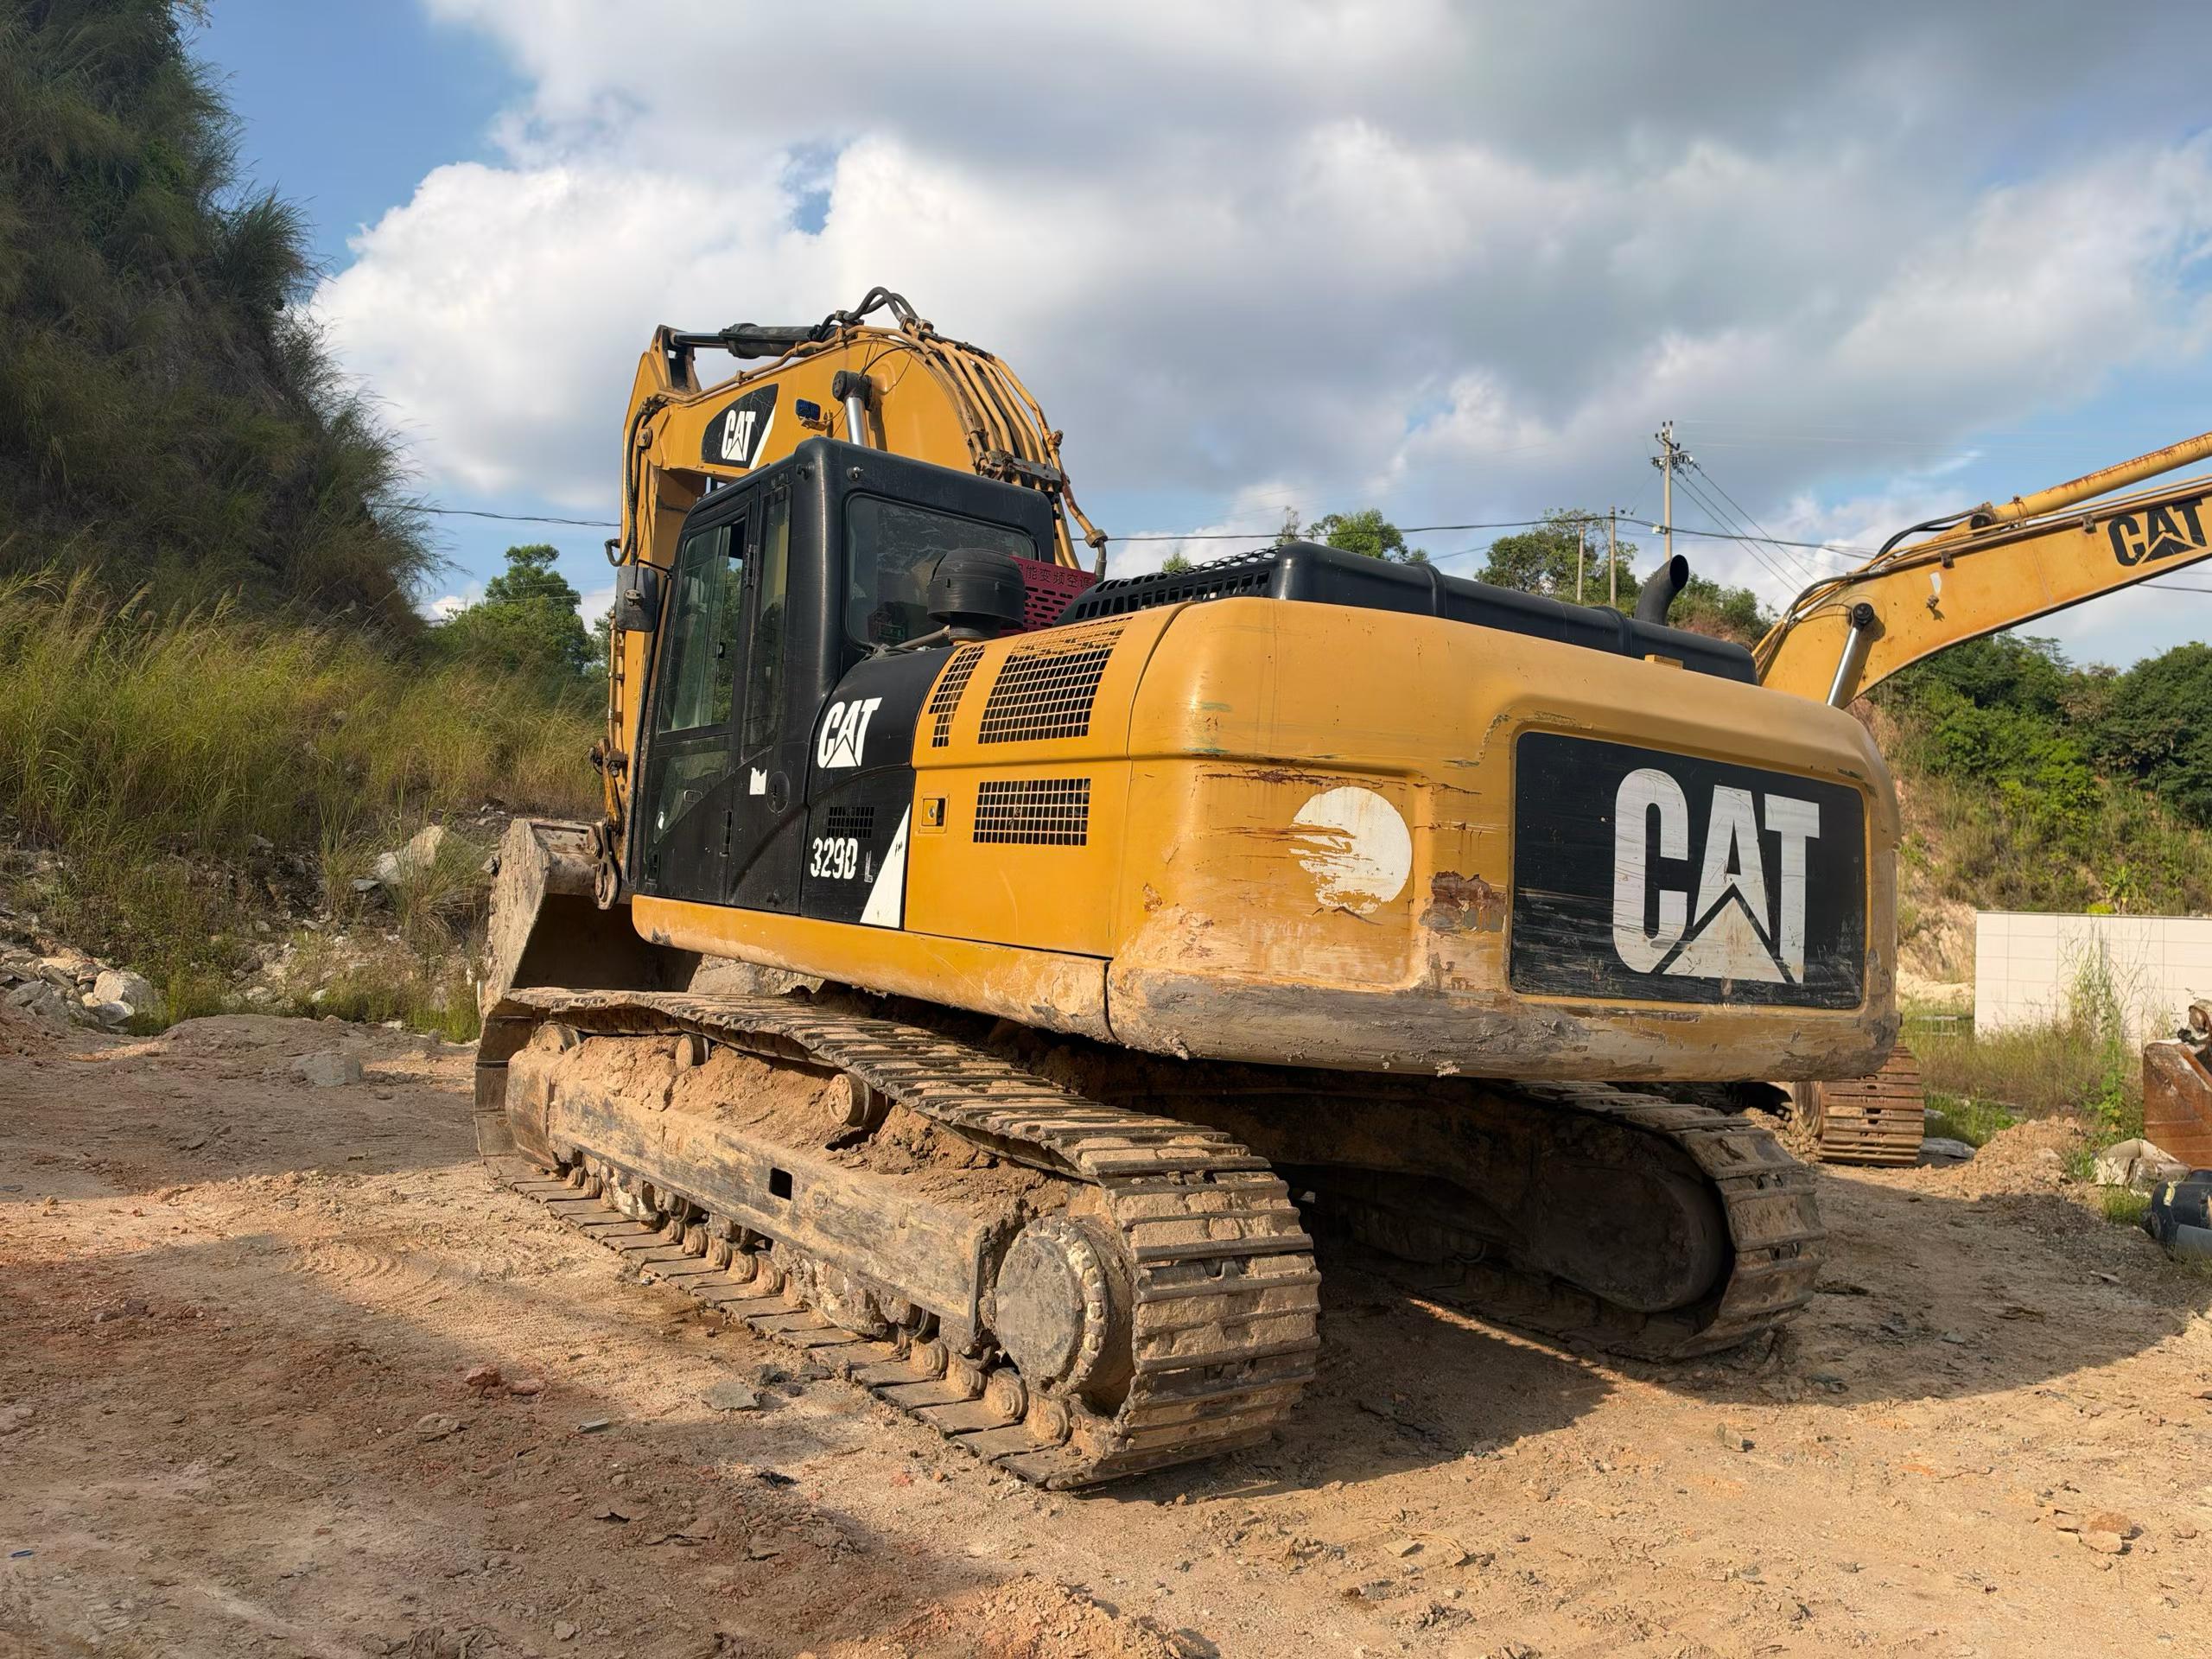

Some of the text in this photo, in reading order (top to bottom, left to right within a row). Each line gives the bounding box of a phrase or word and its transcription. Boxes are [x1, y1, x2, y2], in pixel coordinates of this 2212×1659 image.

[721, 410, 756, 461] CAT
[2107, 497, 2207, 566] CAT
[1018, 563, 1093, 588] 能变频空调
[817, 697, 882, 768] CAT
[810, 837, 858, 880] 329D
[1613, 768, 1820, 983] CAT
